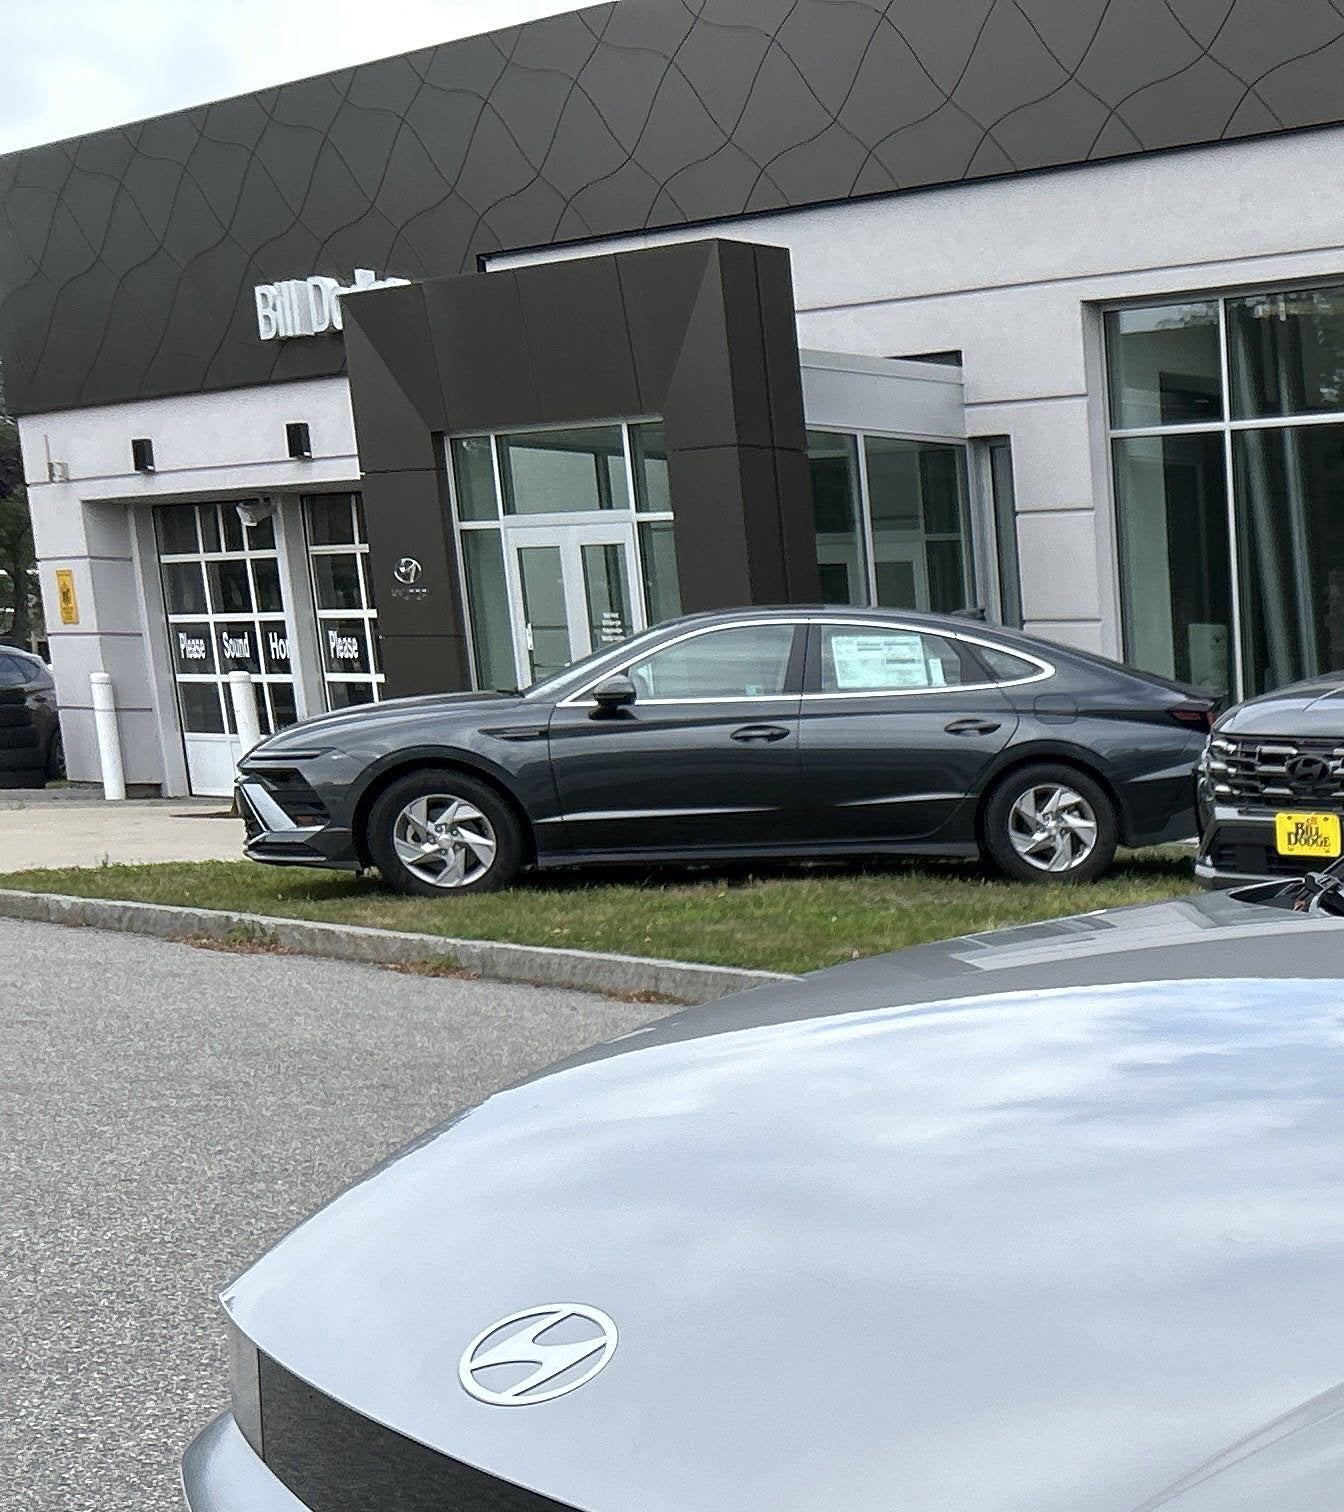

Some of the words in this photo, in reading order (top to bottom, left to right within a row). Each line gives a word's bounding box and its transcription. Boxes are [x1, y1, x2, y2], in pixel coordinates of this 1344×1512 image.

[178, 631, 206, 659] Please
[222, 631, 251, 659] Sound
[267, 631, 290, 660] Ho
[328, 630, 359, 659] Please
